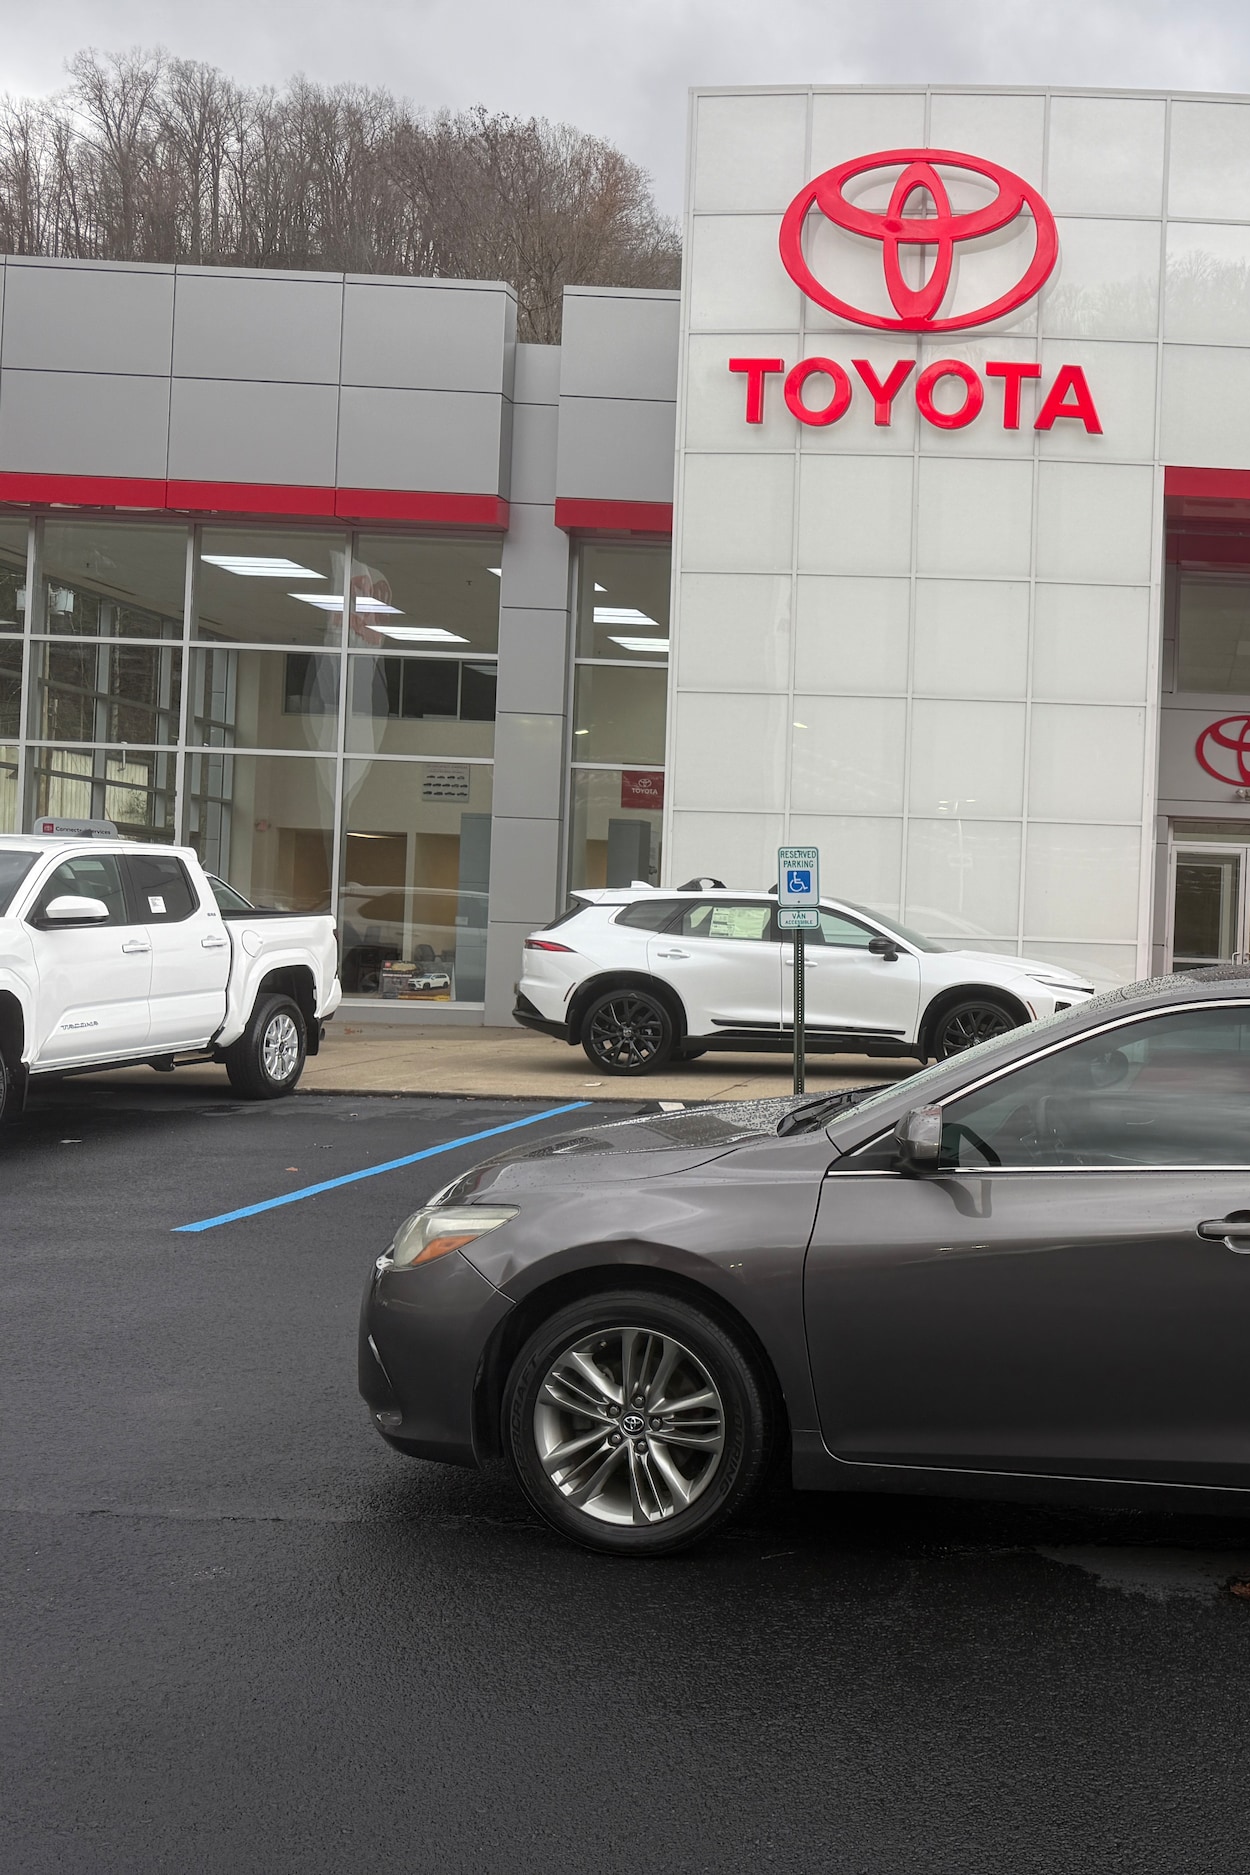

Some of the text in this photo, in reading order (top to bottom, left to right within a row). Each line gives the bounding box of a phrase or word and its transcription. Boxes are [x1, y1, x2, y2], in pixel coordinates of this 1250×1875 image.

[729, 357, 1104, 435] TOYOTA
[632, 787, 658, 795] TOYOTA
[780, 850, 817, 859] RESERVED
[783, 860, 814, 868] PARKING
